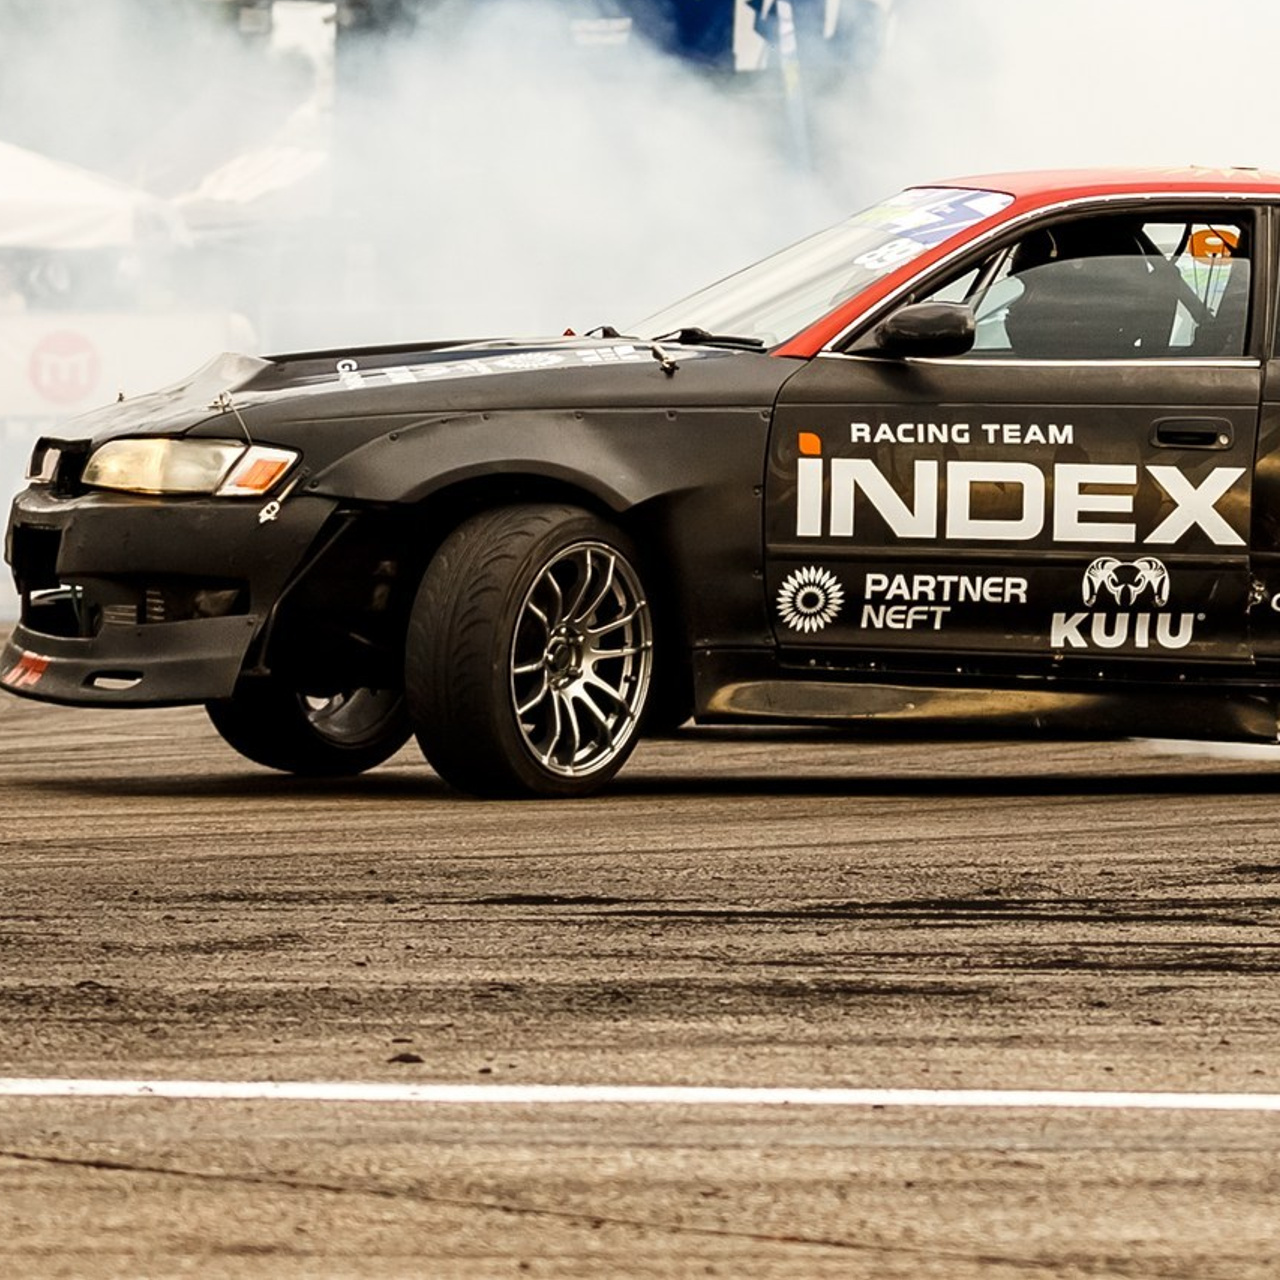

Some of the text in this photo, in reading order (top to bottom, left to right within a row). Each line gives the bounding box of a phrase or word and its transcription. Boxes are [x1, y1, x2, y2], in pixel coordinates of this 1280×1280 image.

[850, 422, 1075, 445] RACING TEAM
[864, 572, 1029, 605] PARTNER
[860, 604, 952, 631] NEFT
[1050, 612, 1195, 649] KUIU
